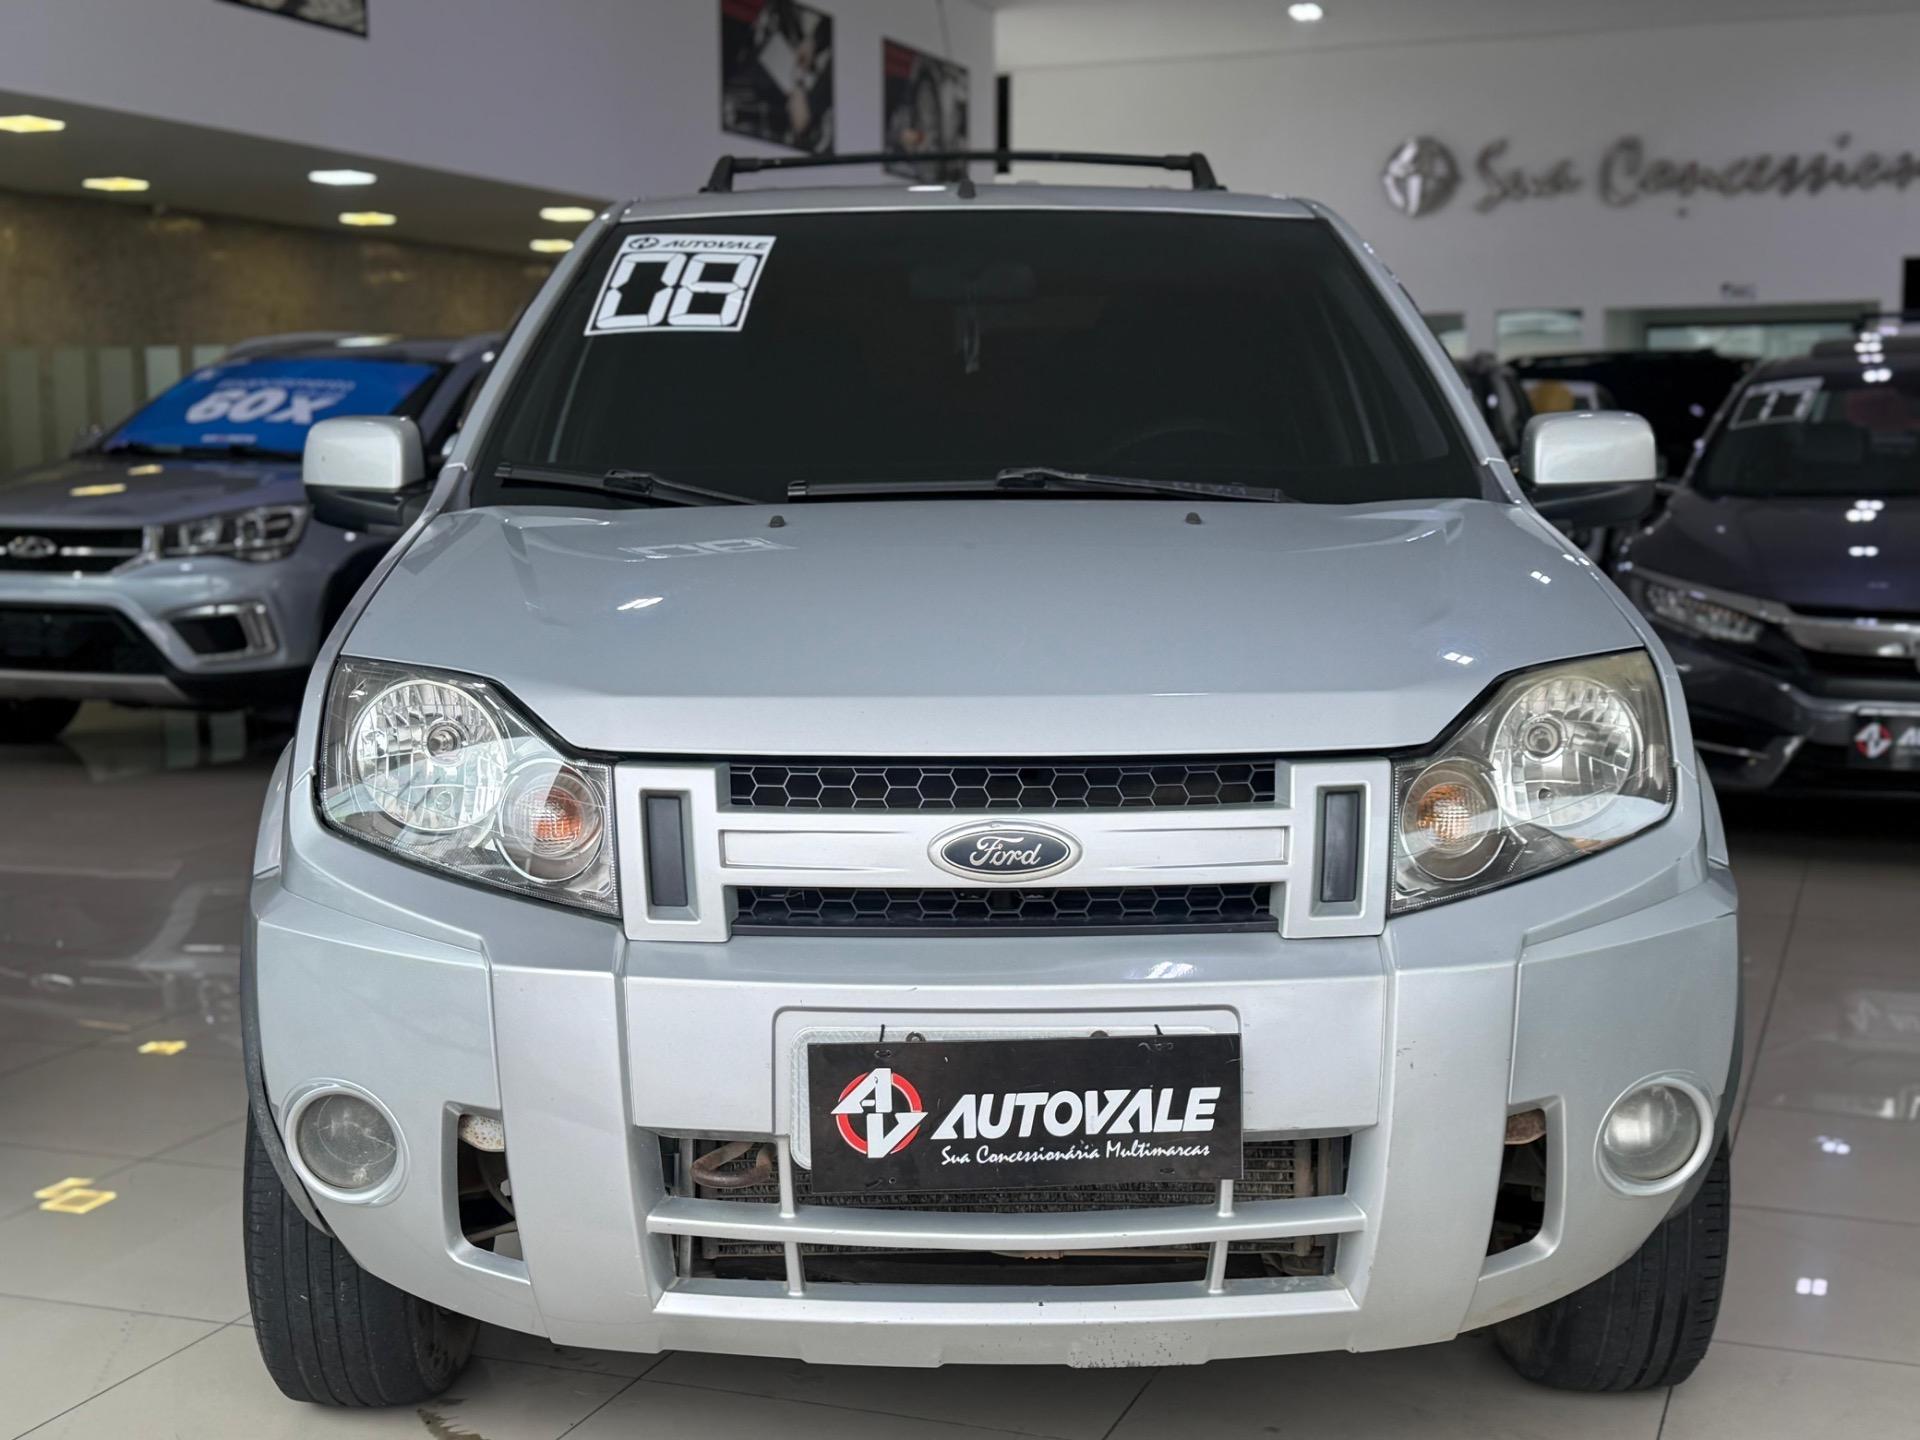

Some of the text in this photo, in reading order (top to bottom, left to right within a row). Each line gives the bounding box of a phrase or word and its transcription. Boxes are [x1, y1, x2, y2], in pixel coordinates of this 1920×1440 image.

[1474, 137, 1583, 215] Sua
[661, 238, 769, 250] AUTOVALE
[595, 253, 758, 328] 08
[969, 836, 1042, 866] Ford
[931, 1087, 1221, 1140] AUTOVALE
[941, 1139, 1211, 1165] Sua Concessionária Multimarcas
